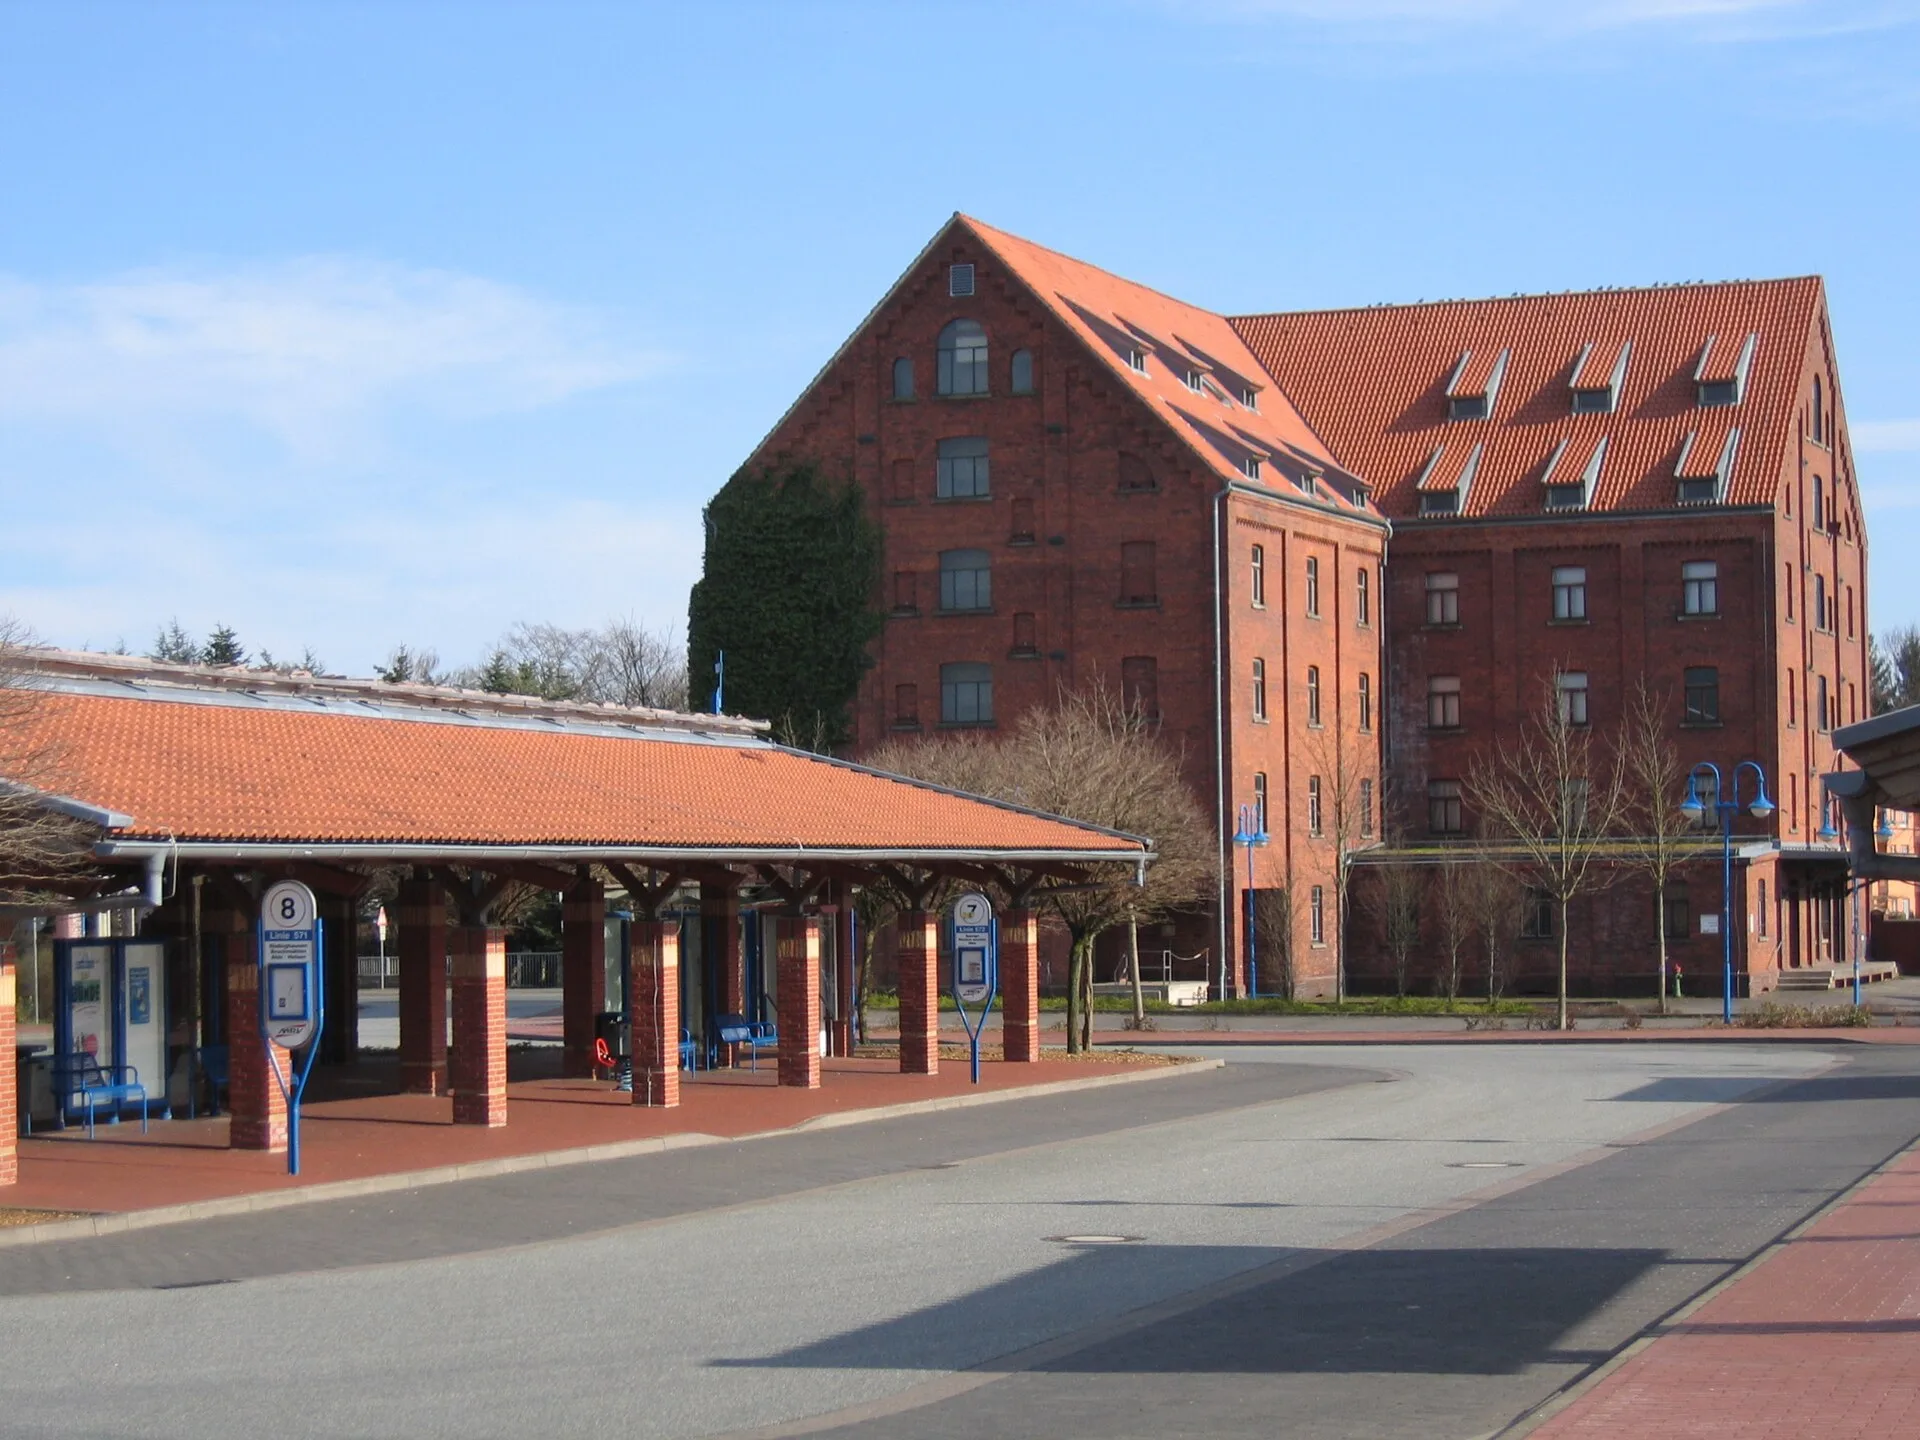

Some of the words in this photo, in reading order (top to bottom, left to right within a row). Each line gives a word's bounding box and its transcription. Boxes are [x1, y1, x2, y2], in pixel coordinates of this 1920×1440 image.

[281, 897, 295, 919] 8
[967, 904, 977, 917] 7
[269, 931, 290, 939] Linie
[294, 931, 308, 939] 571
